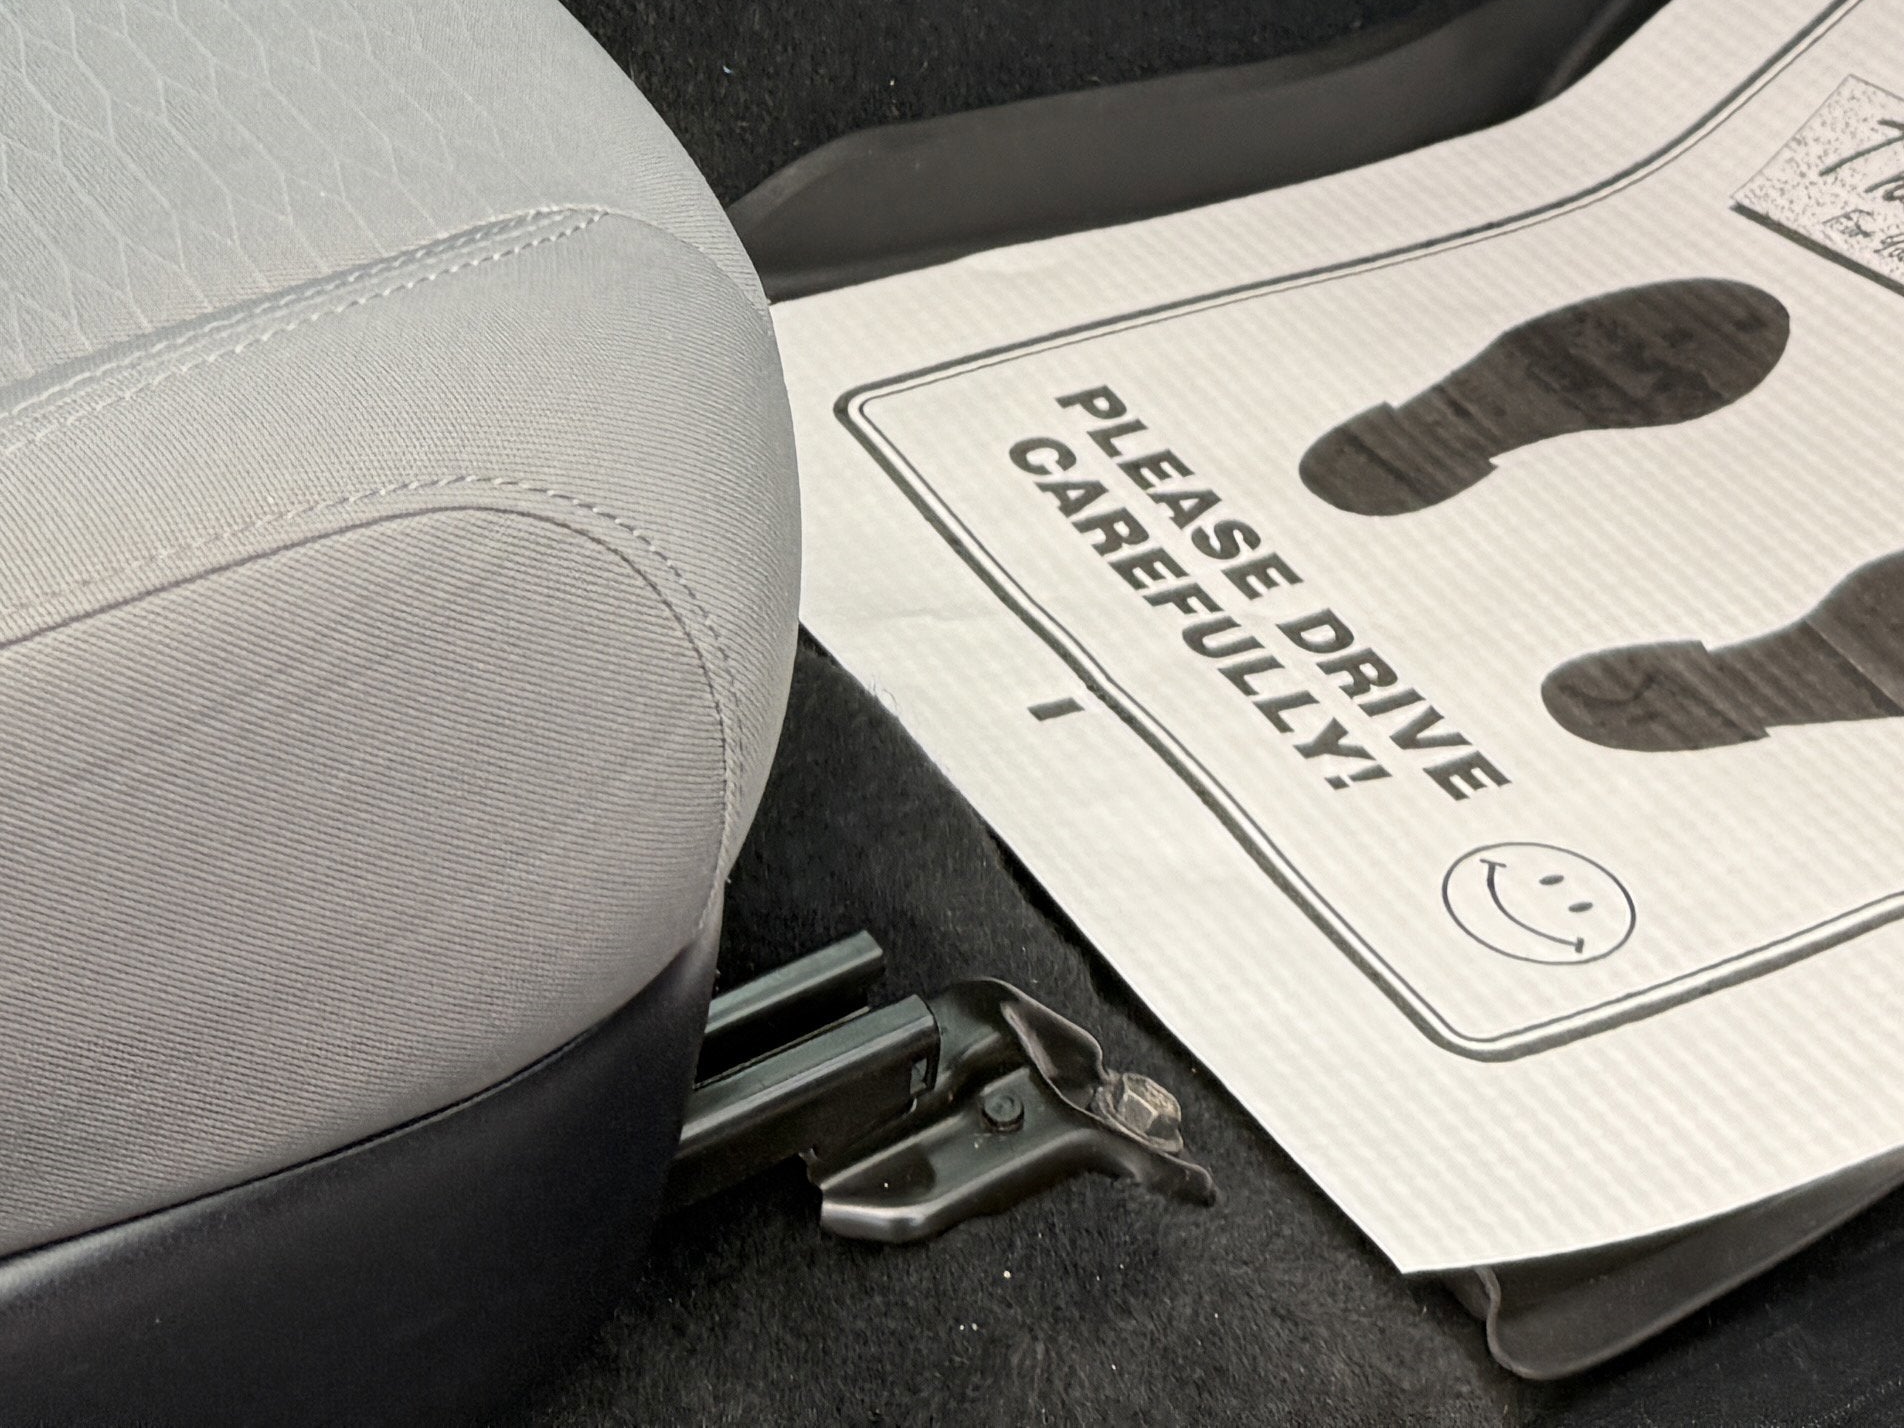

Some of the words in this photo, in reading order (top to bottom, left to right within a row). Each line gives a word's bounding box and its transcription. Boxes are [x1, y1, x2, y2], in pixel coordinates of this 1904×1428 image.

[1822, 208, 1876, 241] For
[1005, 432, 1389, 795] CAREFULLY!
[1055, 380, 1307, 604] PLEASE
[1276, 603, 1512, 805] DRIVE
